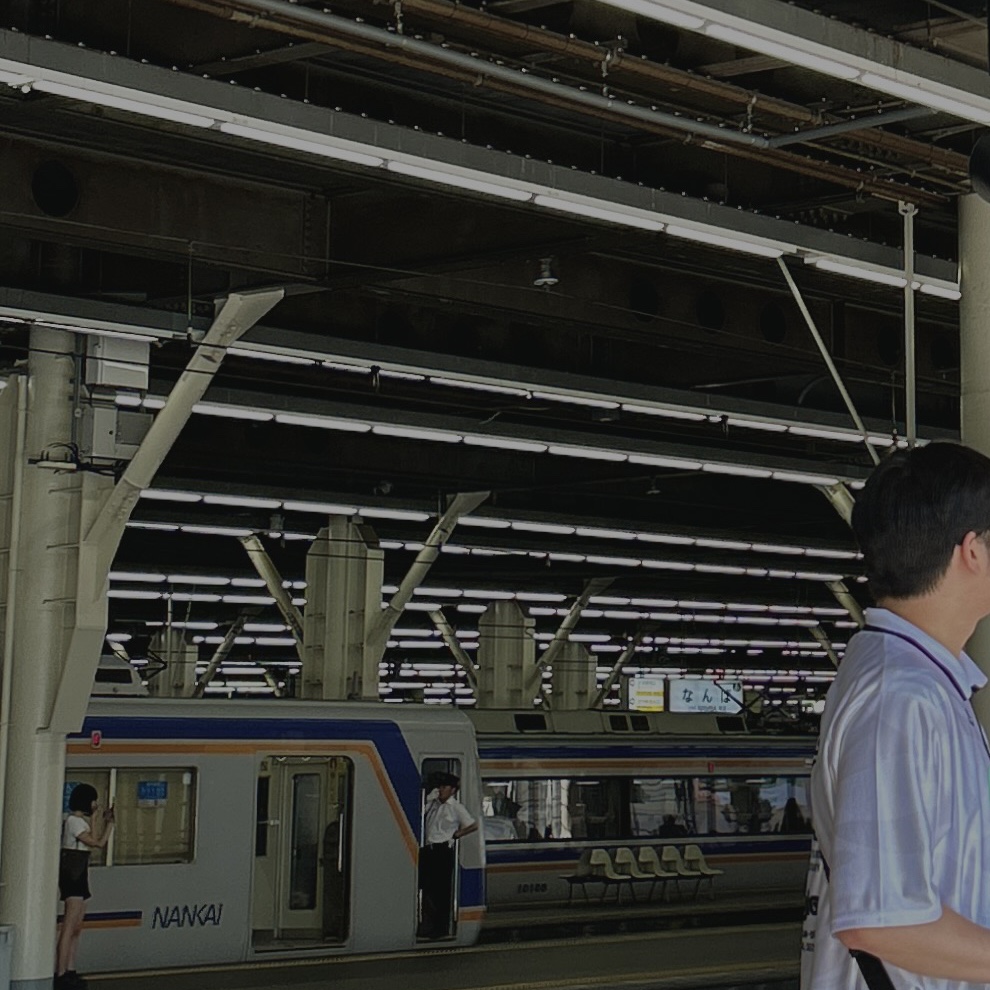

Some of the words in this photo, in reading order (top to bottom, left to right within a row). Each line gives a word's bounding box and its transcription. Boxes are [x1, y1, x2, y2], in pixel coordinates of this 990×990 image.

[682, 689, 732, 703] なんば
[152, 903, 223, 929] NANKAI
